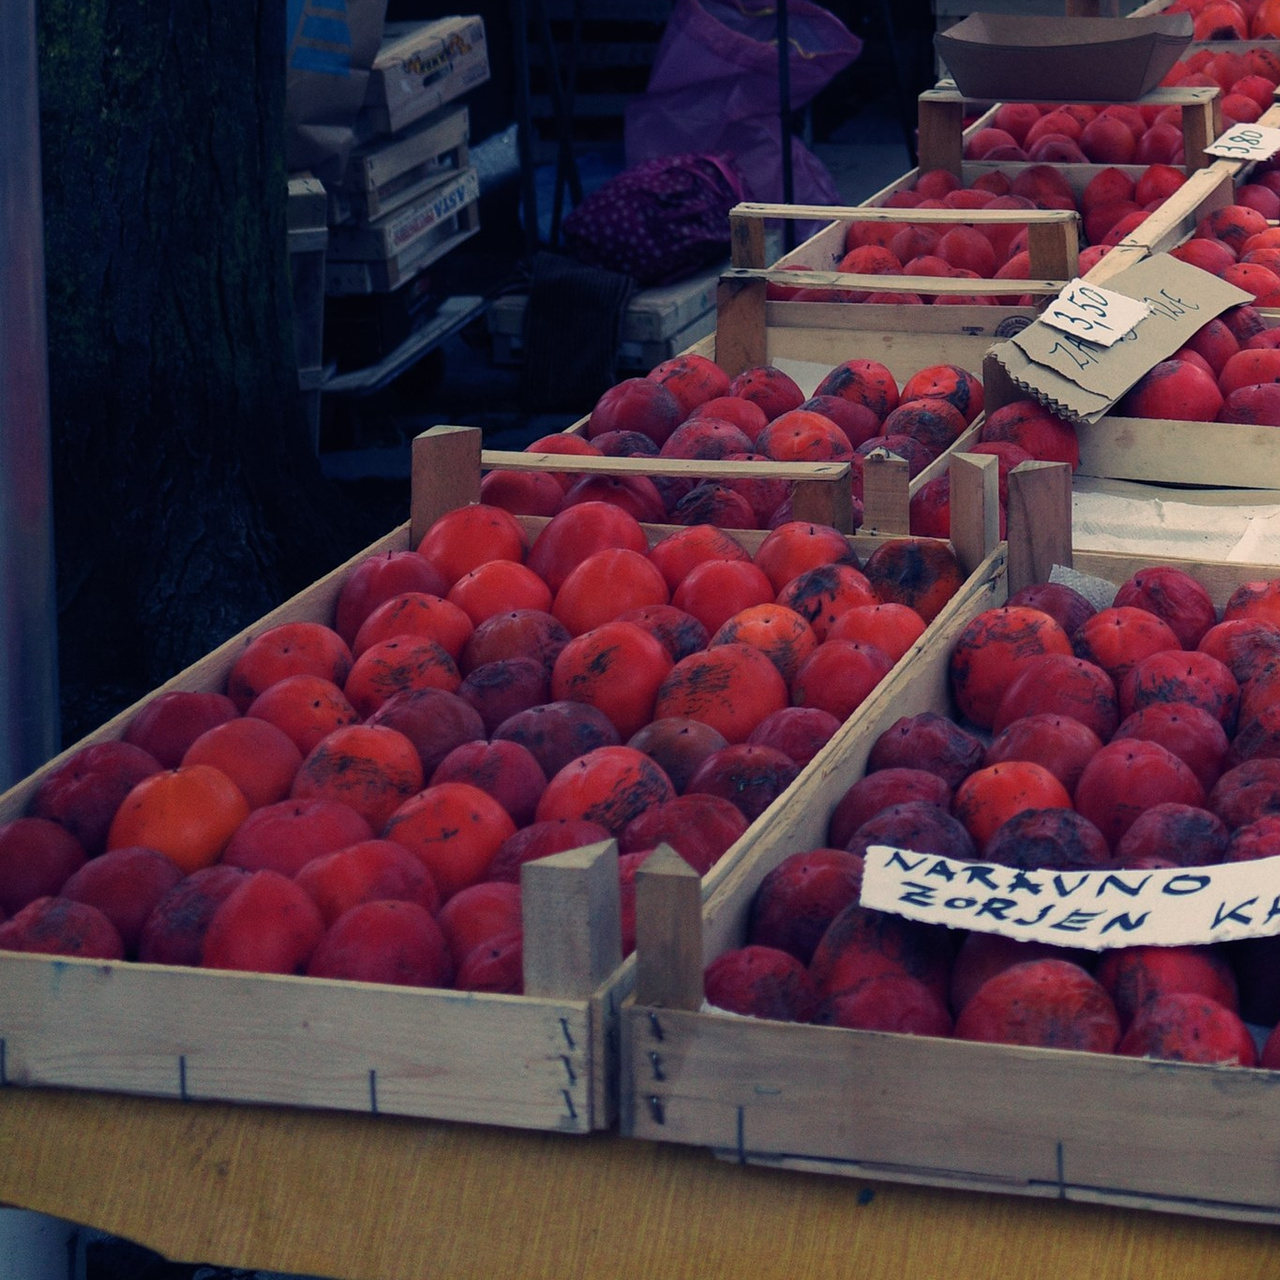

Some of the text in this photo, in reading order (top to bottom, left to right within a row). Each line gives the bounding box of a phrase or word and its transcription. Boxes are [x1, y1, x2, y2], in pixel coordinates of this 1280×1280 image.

[1214, 130, 1266, 154] 3,80
[1054, 286, 1114, 331] 3,50
[883, 850, 1211, 899] NARAVNO
[899, 880, 1152, 935] ZORJEN
